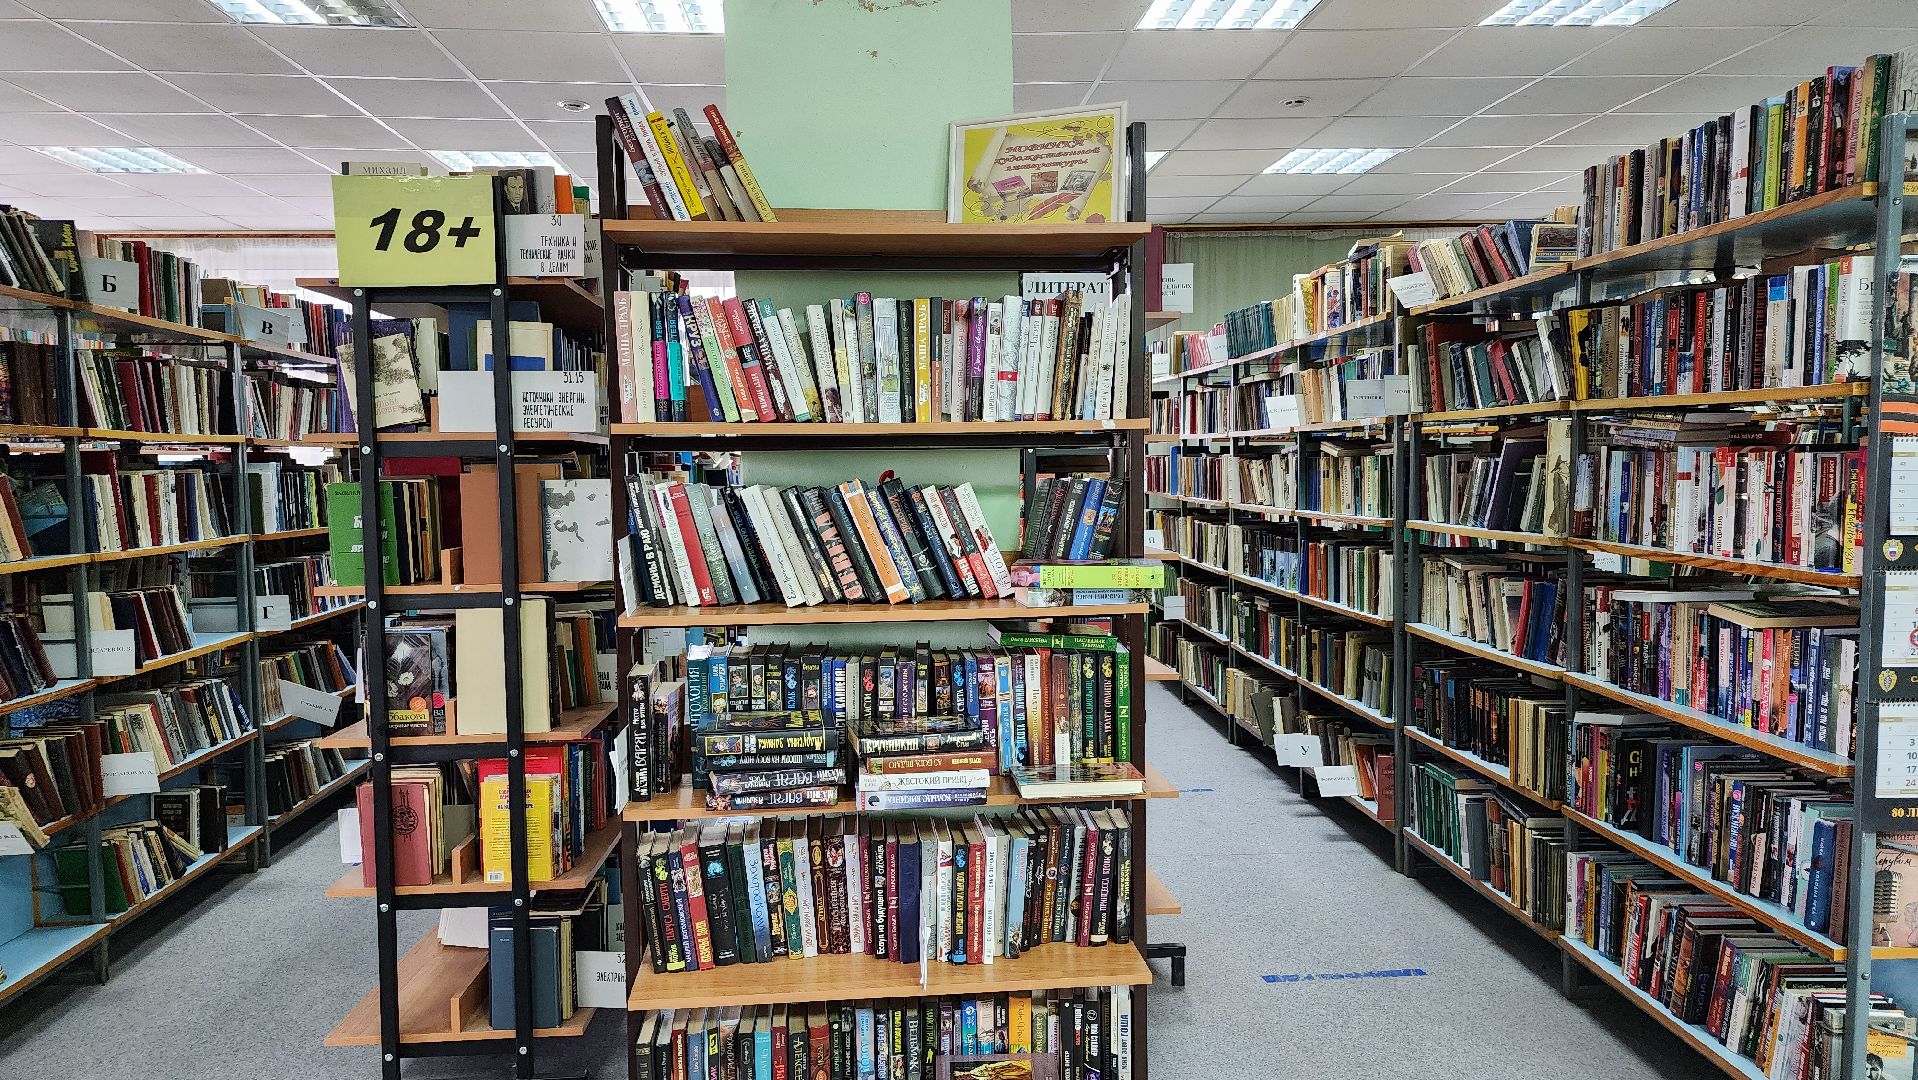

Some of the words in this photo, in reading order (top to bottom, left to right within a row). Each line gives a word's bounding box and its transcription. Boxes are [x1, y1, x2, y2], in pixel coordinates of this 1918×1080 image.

[369, 206, 482, 254] 18+
[551, 215, 562, 226] 30
[541, 235, 569, 247] ТЕХНИКА
[101, 274, 117, 293] Б
[261, 320, 273, 334] В
[621, 333, 631, 367] МАША
[918, 338, 926, 370] МАША
[563, 372, 584, 384] 31.15
[522, 404, 574, 416] ЭНЕРГЕТИЧЕСКИЕ
[523, 417, 553, 428] РЕСУРСЫ
[646, 561, 666, 600] ДЕМОНЫ
[262, 605, 274, 620] Г
[689, 667, 702, 733] АНТОЛОГИЯ
[634, 729, 647, 766] ВАРЯГ
[866, 738, 919, 753] БРУСНИКИН
[773, 772, 812, 787] ВАРЯГ
[897, 776, 940, 786] ЖЕСТОКИЙ
[768, 793, 802, 804] ВАРЯГ
[1891, 807, 1904, 818] 80
[659, 883, 670, 911] СМЕРТИ
[1100, 877, 1109, 911] ПРИНЦЕССА
[875, 890, 885, 923] будущего
[664, 914, 675, 941] ПАРУСА
[1120, 1014, 1129, 1037] ГОША
[909, 1020, 919, 1071] ВЕДЬМАК
